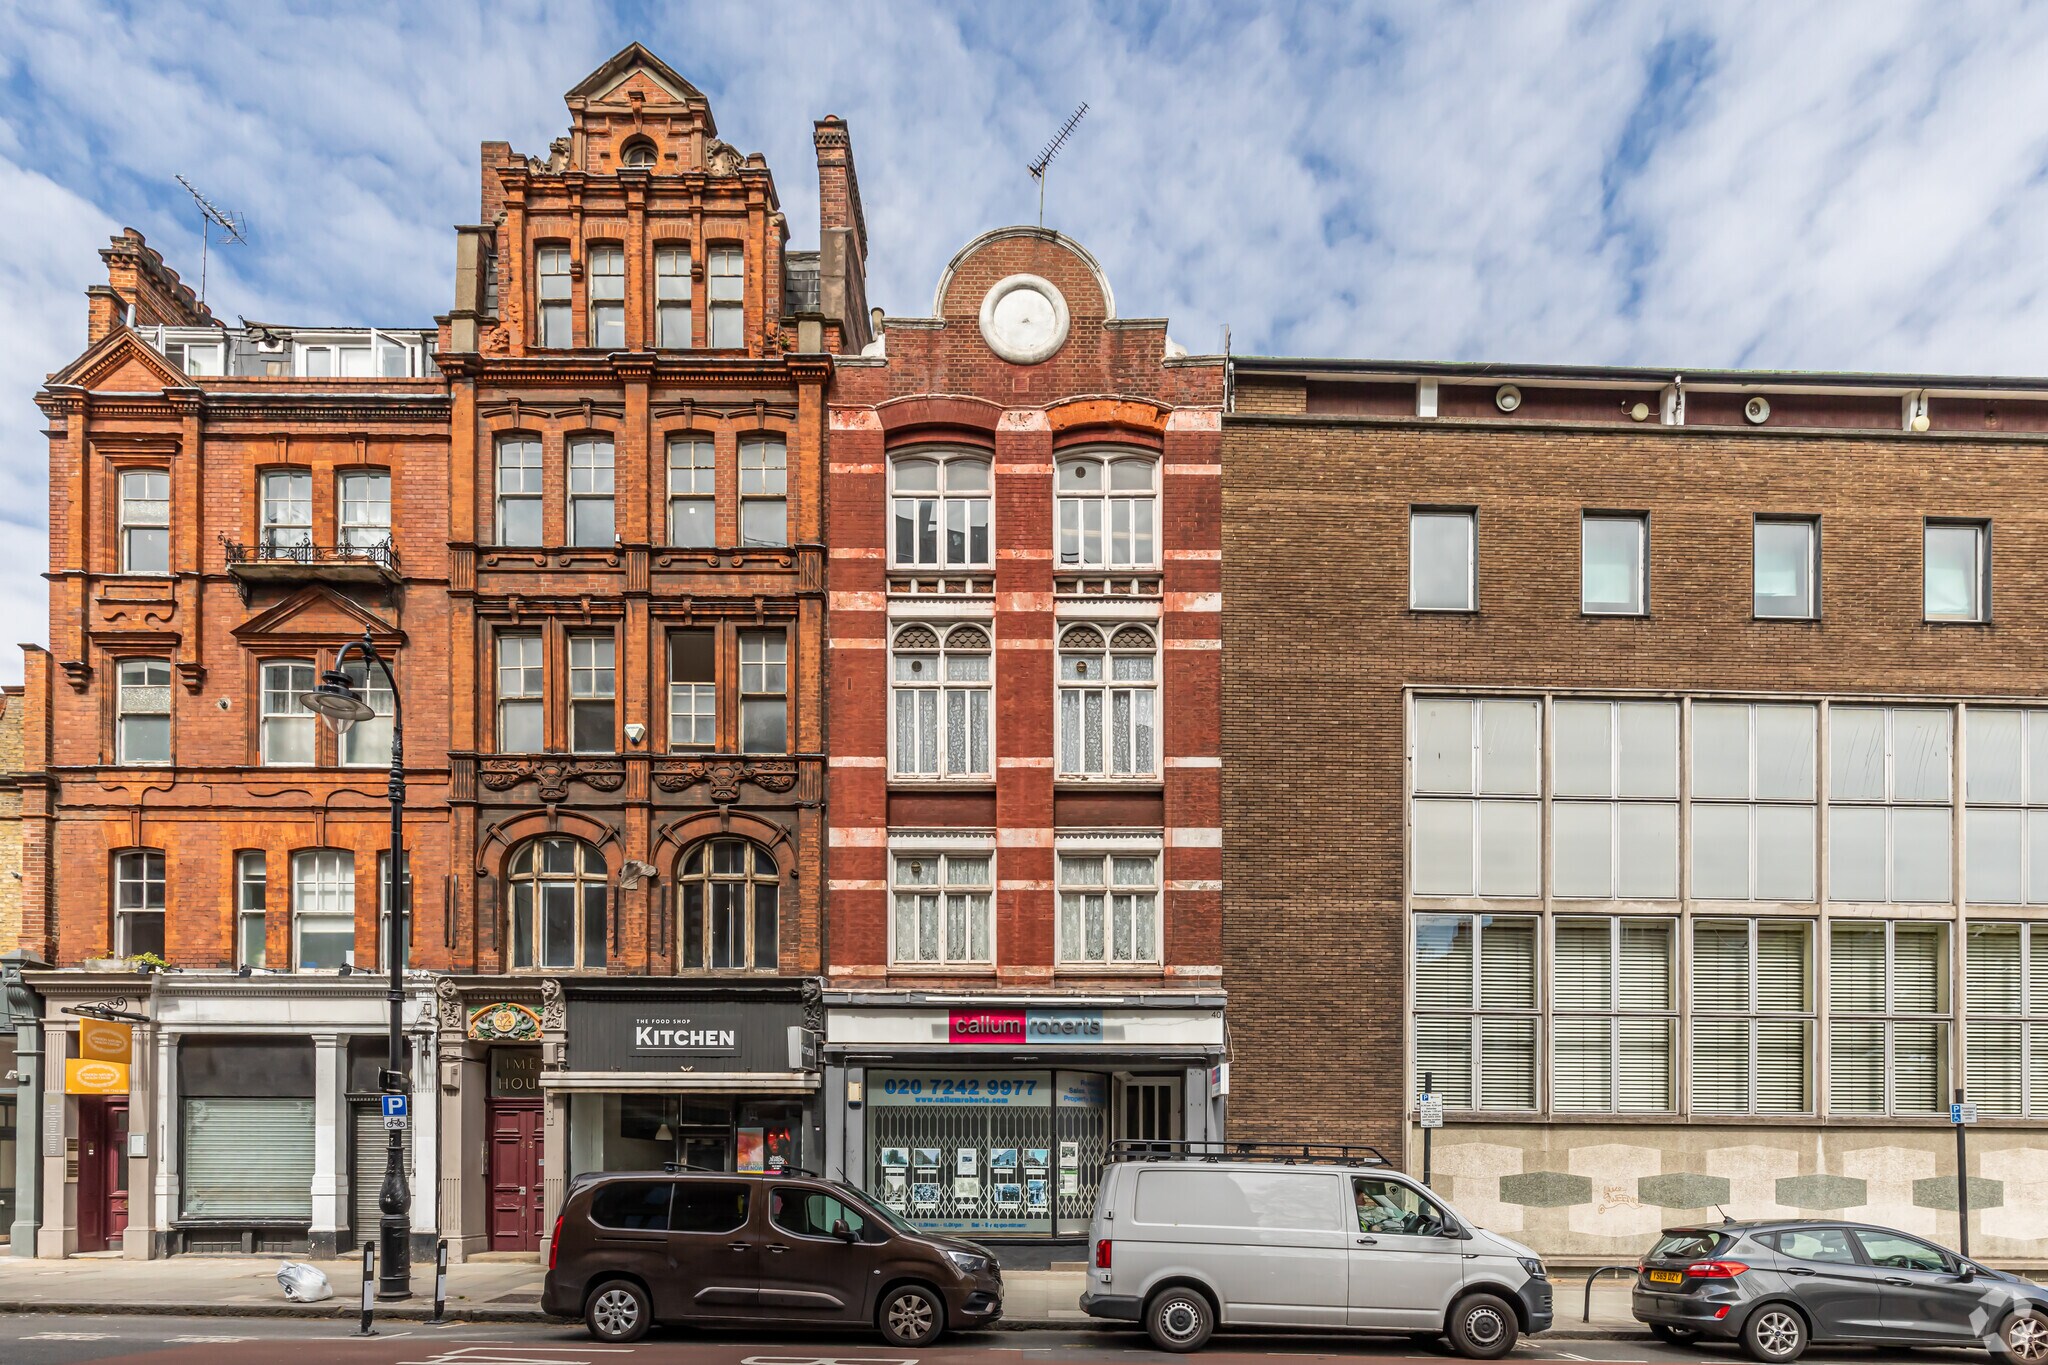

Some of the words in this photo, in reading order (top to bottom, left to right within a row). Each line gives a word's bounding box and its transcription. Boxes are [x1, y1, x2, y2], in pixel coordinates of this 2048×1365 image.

[1211, 1010, 1221, 1019] 40
[956, 1016, 1020, 1034] callum
[1029, 1017, 1100, 1035] roberts
[498, 1077, 536, 1089] HOU
[885, 1078, 922, 1095] 020
[930, 1078, 980, 1096] 7242
[987, 1079, 1038, 1096] 9977
[388, 1098, 401, 1114] P
[915, 1096, 1009, 1104] www.callumroberts.com
